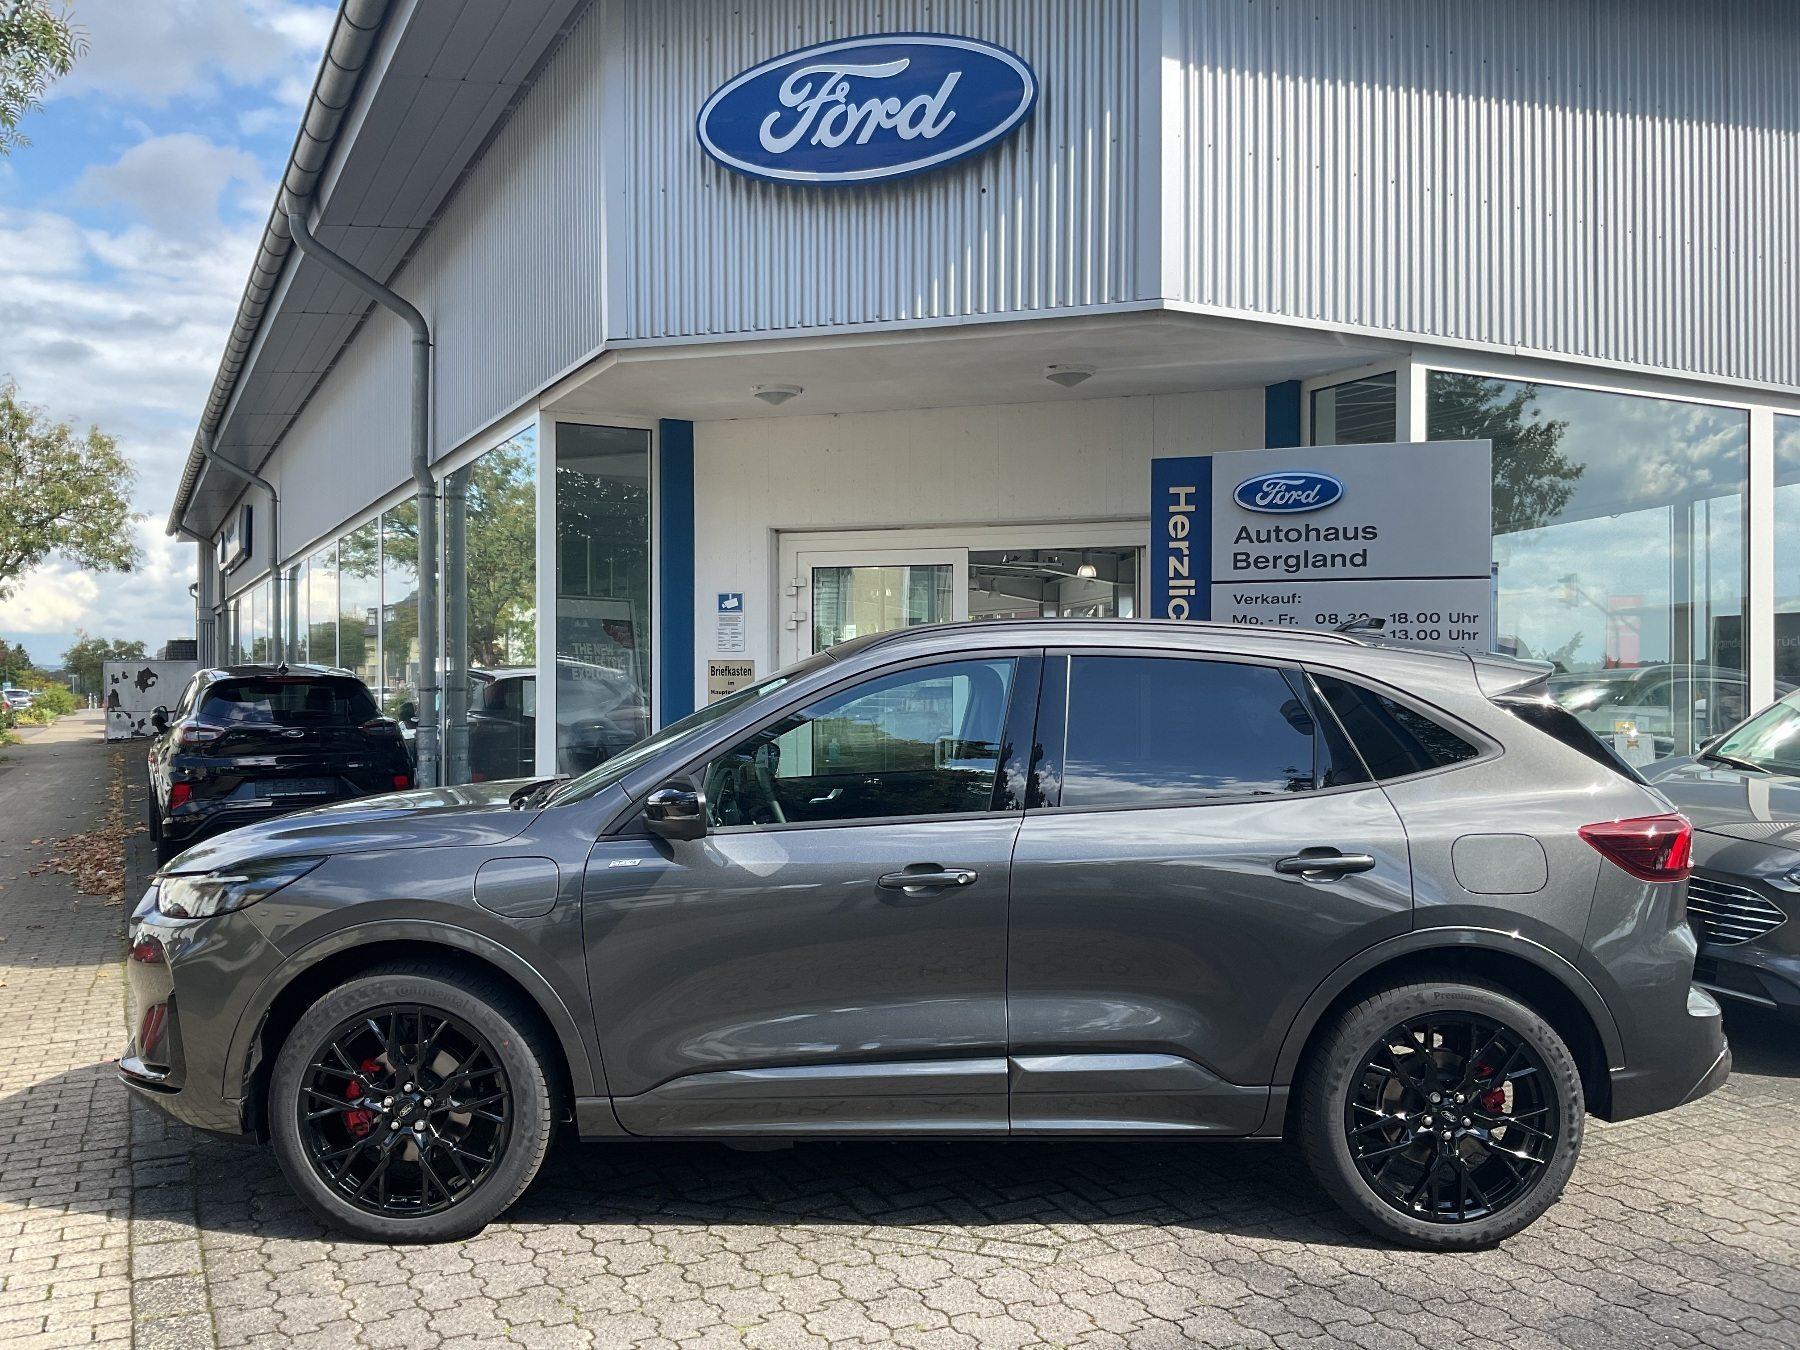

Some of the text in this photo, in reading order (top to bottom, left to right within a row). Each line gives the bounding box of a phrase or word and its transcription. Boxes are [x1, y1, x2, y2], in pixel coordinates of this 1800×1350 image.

[759, 58, 962, 153] Ford
[1255, 479, 1322, 506] Ford
[1233, 524, 1378, 545] Autohaus
[1232, 549, 1368, 574] Bergland
[1233, 593, 1301, 605] Verkauf:
[1232, 614, 1264, 625] Mo.
[1279, 613, 1299, 624] Fr.
[1389, 612, 1441, 624] 18.00
[1448, 612, 1479, 624] Uhr
[1389, 629, 1479, 641] 13.00 Uhr
[710, 665, 752, 677] Briefkasten
